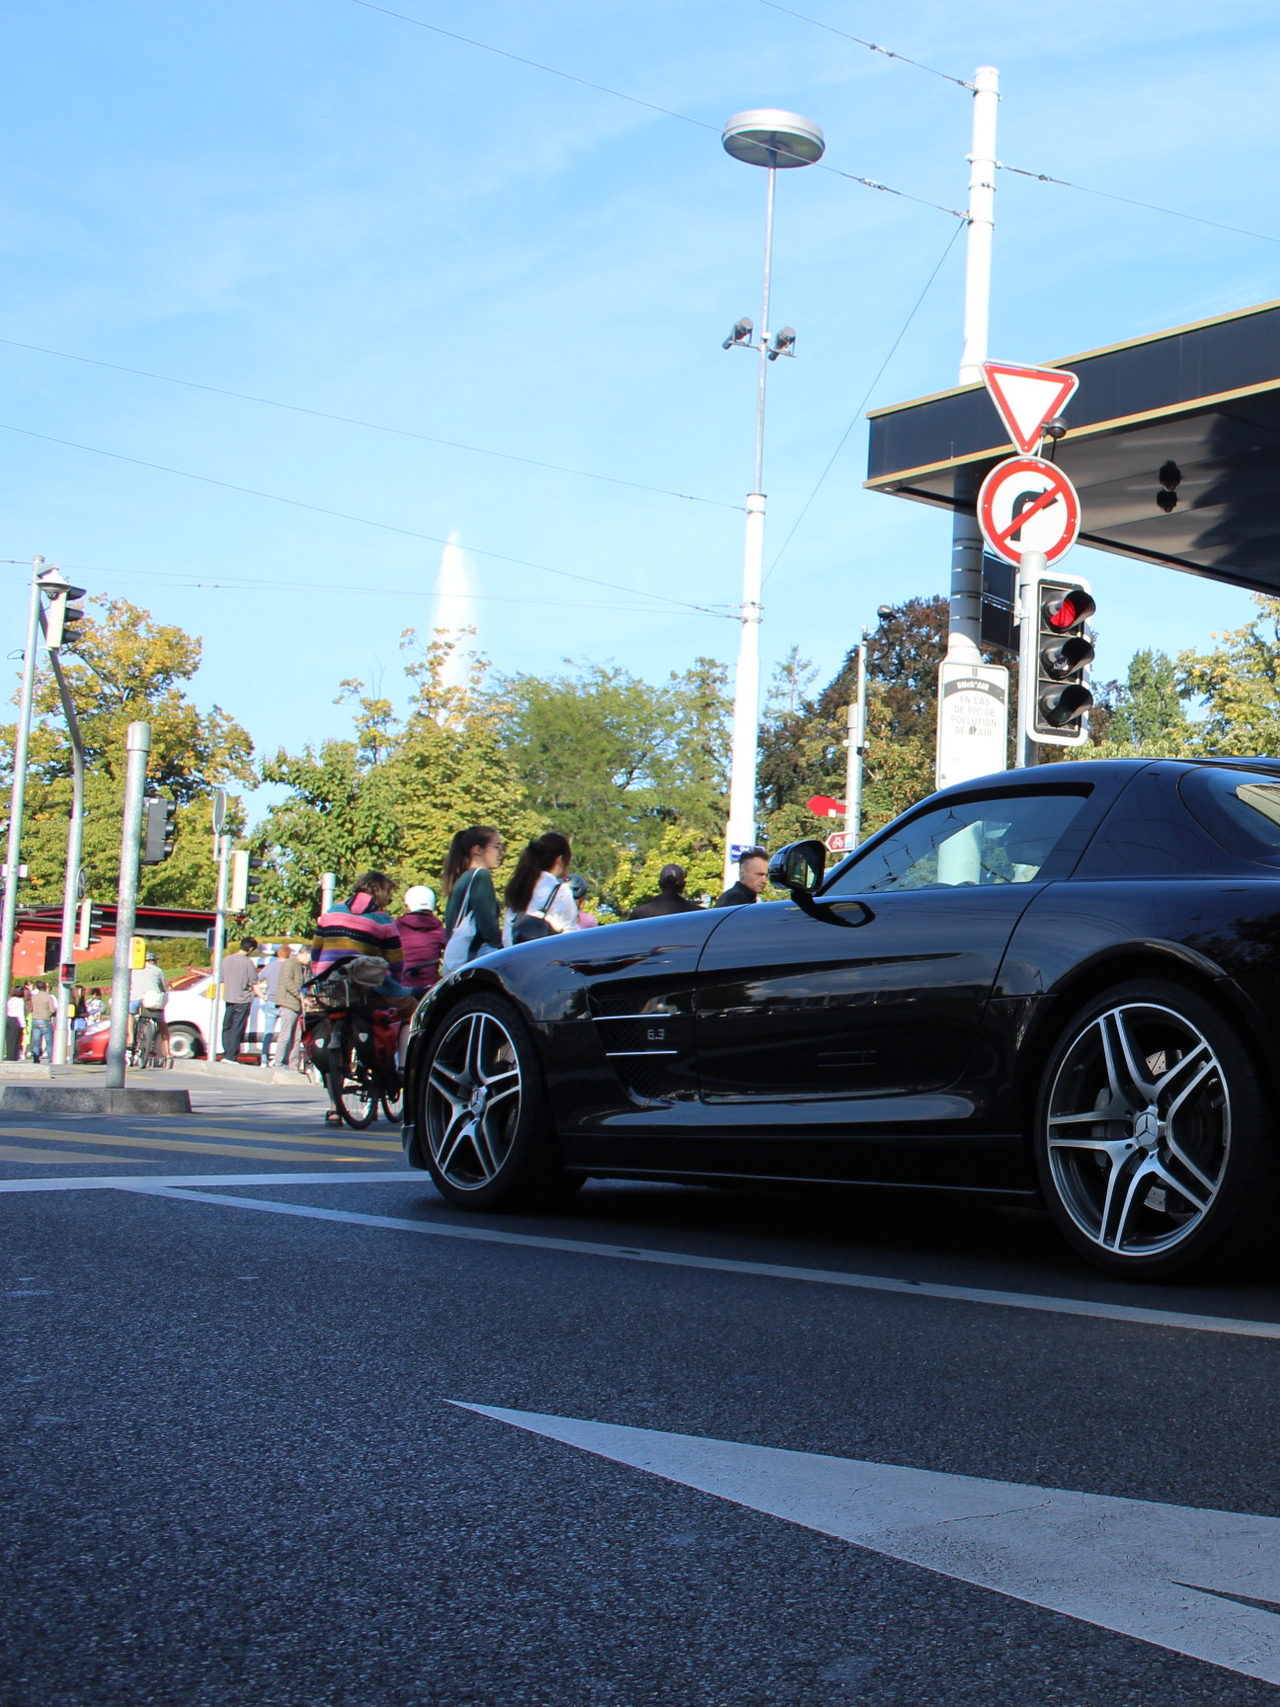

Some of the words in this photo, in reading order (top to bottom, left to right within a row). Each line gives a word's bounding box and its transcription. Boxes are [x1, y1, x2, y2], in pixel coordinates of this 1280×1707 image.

[960, 695, 971, 704] EN
[974, 696, 991, 705] CAS
[954, 705, 965, 714] DE
[968, 706, 981, 715] PIC
[984, 707, 995, 717] DE
[951, 715, 997, 727] POLLUTION
[954, 726, 965, 735] DE
[647, 1028, 665, 1040] 6.3
